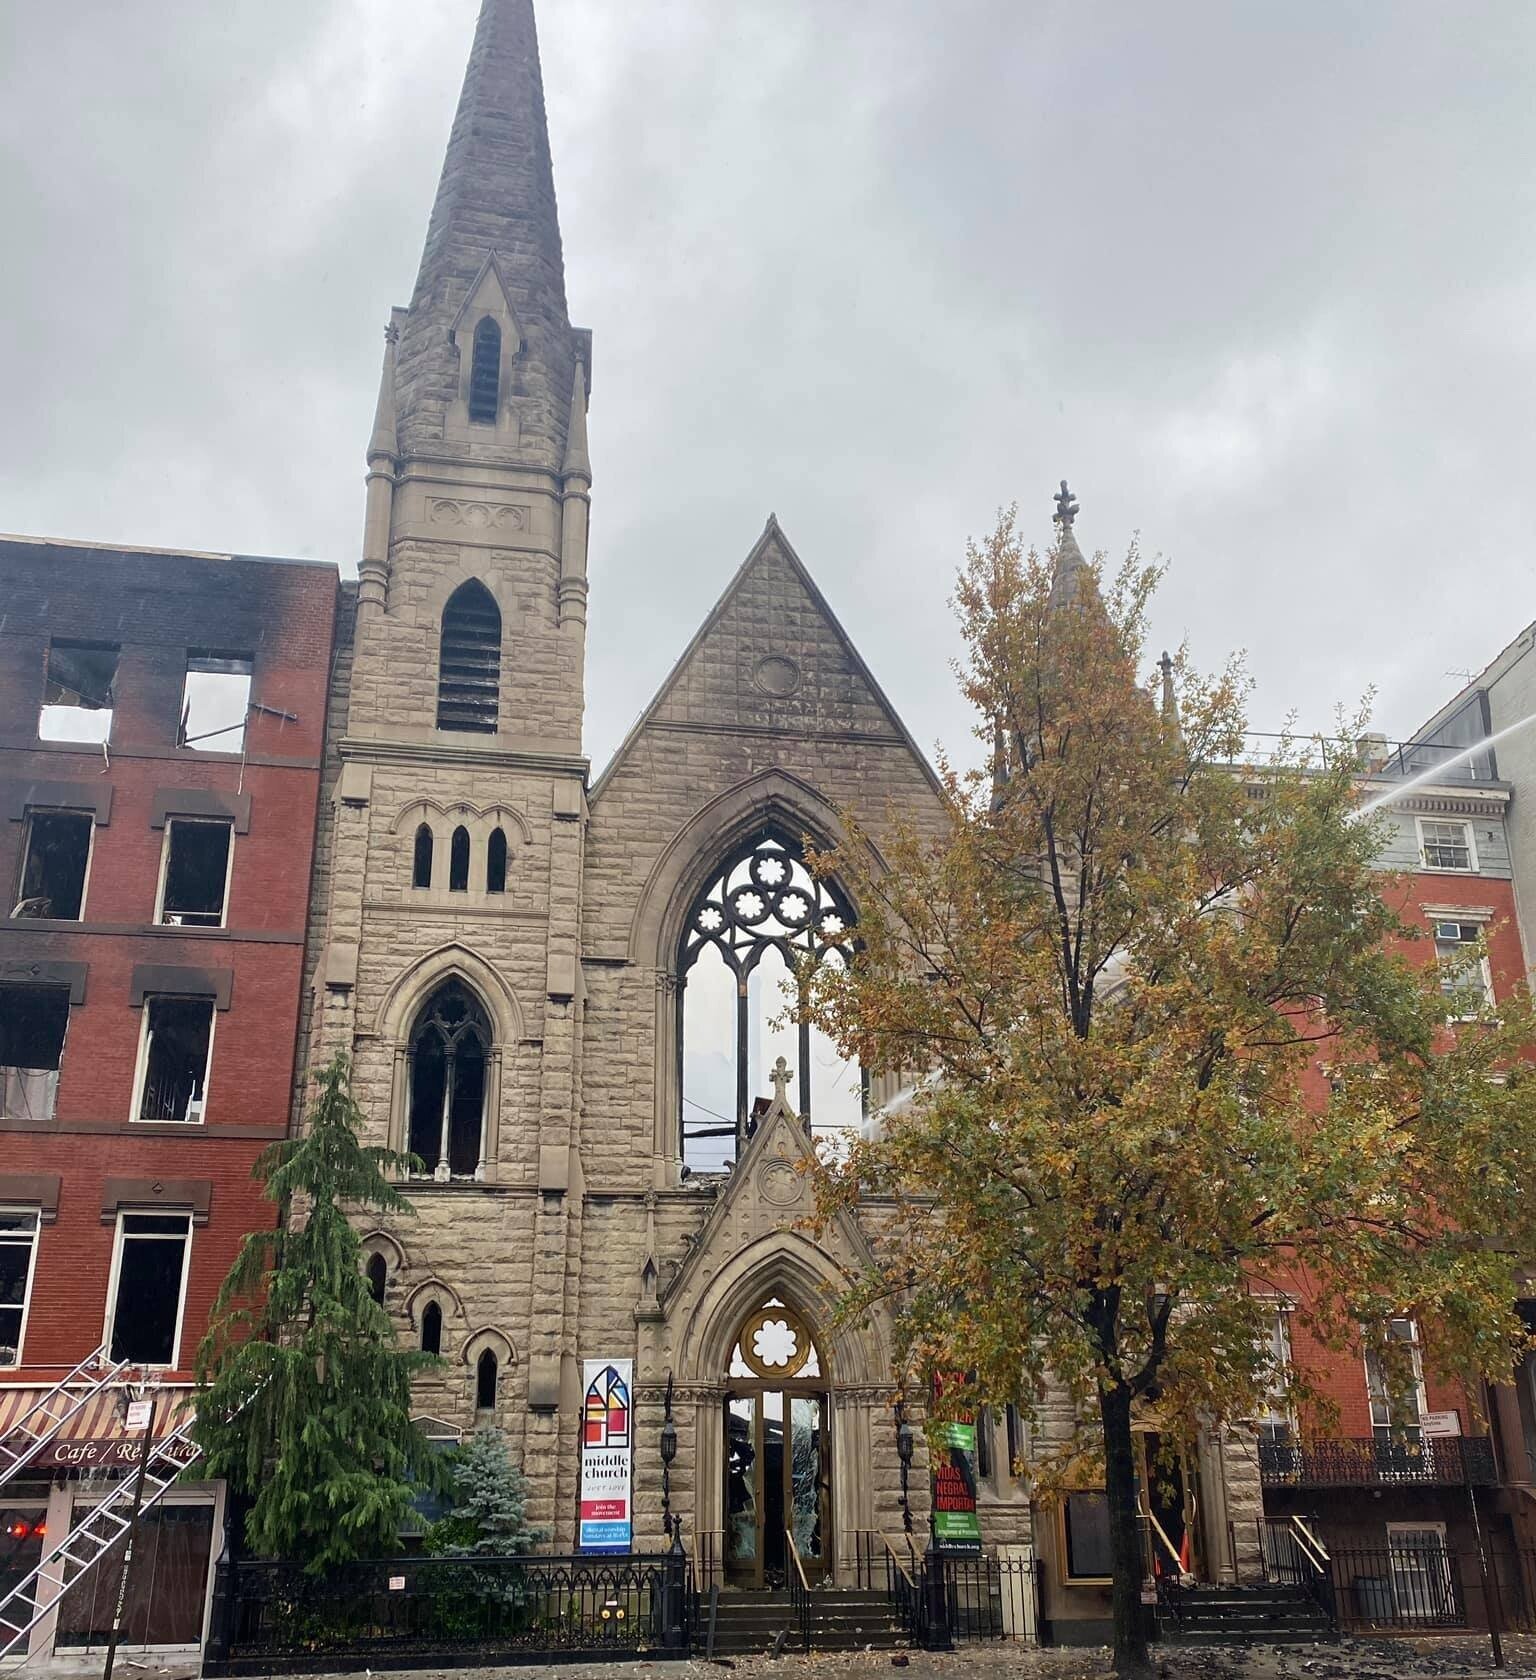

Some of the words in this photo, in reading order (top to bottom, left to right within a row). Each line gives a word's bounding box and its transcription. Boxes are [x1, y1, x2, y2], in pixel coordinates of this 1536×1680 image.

[54, 1441, 96, 1464] Cafe
[584, 1455, 628, 1467] middle
[585, 1467, 628, 1479] church
